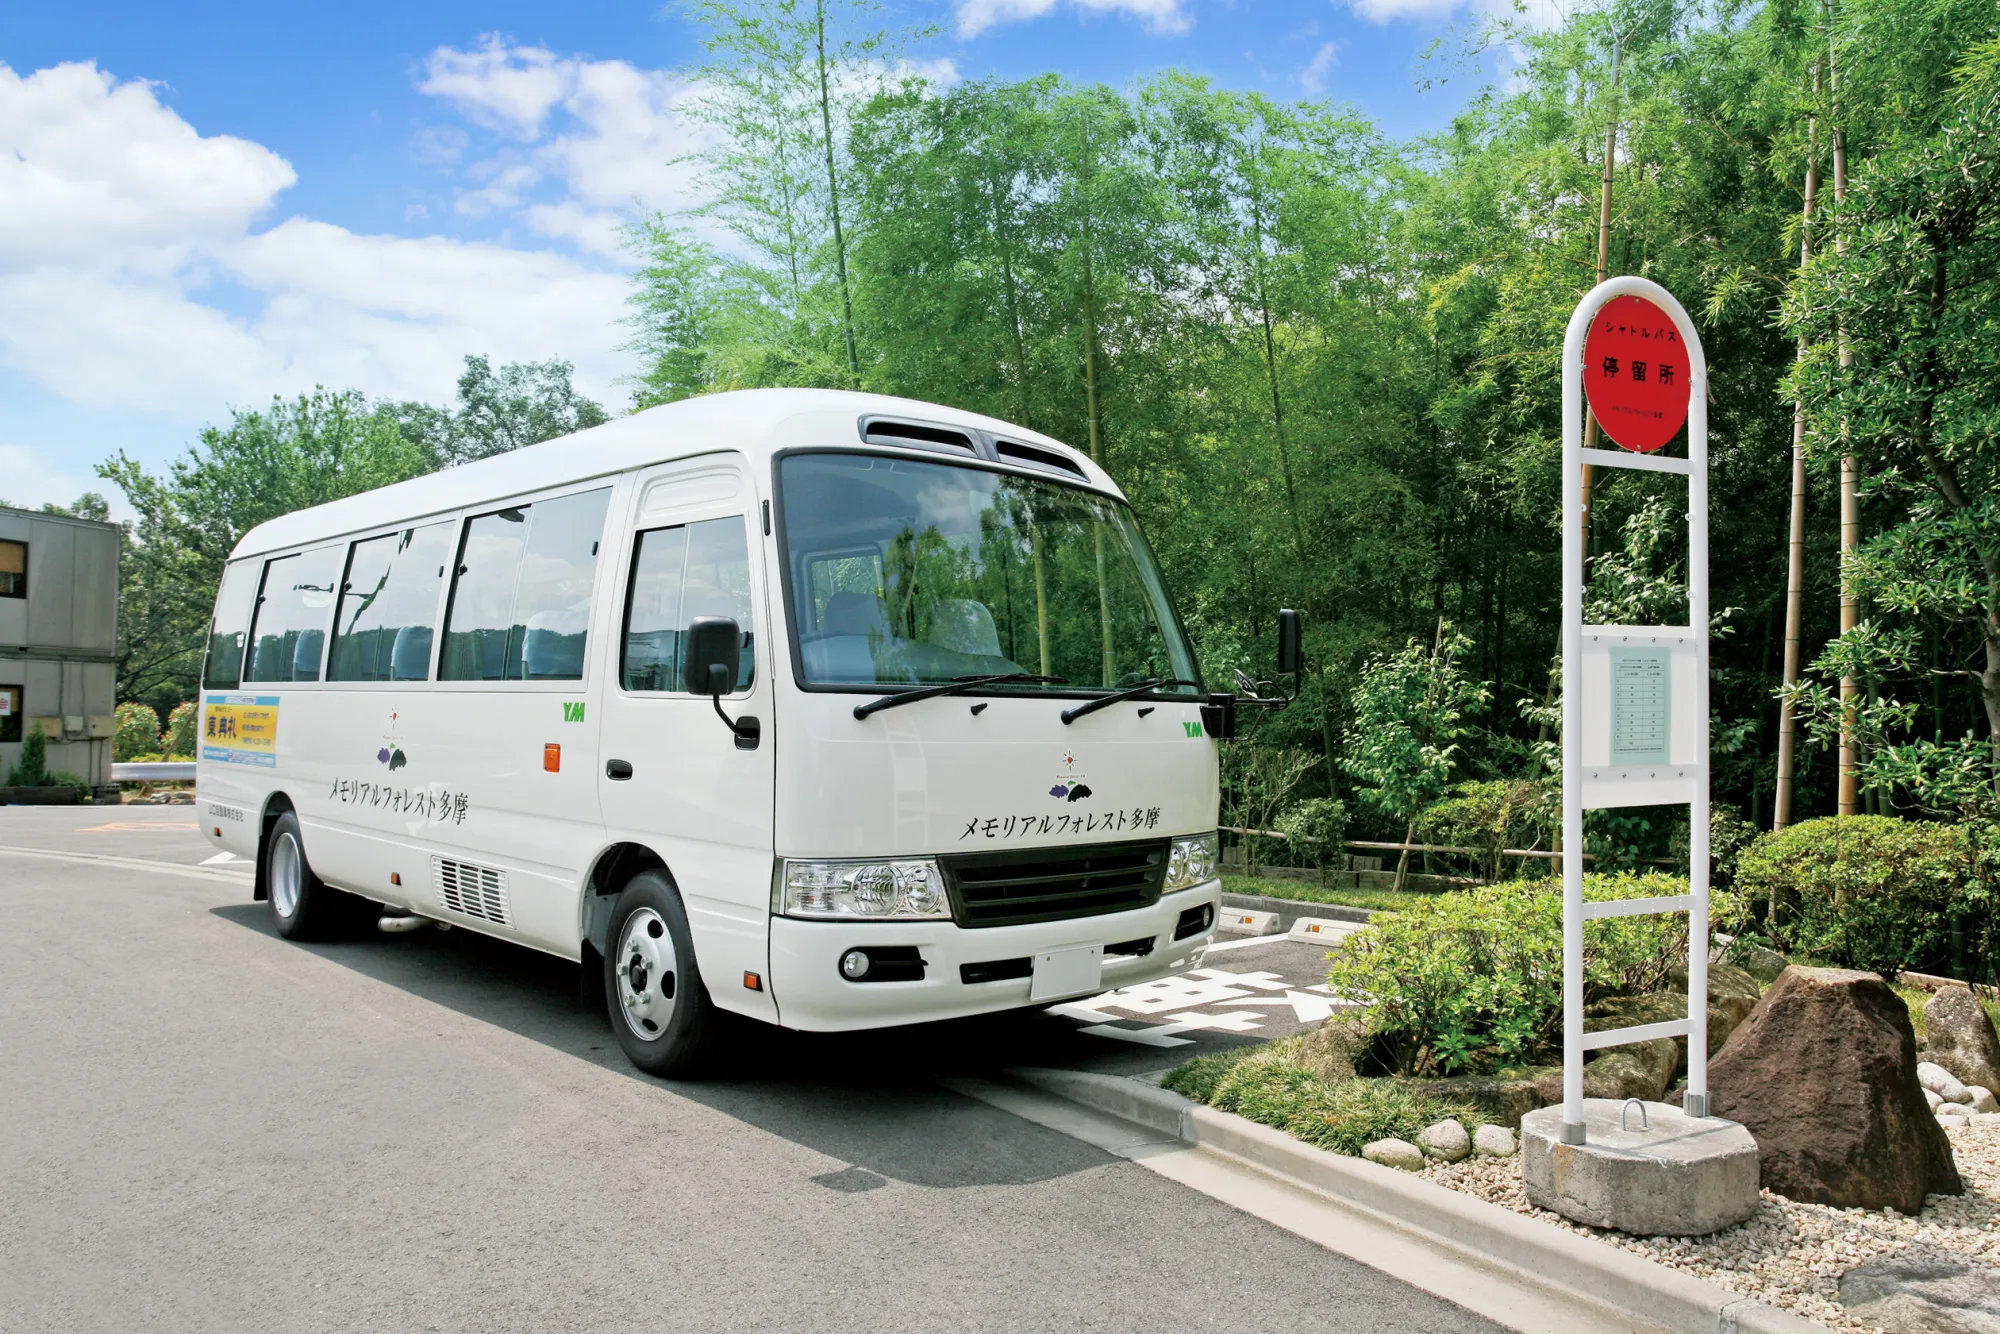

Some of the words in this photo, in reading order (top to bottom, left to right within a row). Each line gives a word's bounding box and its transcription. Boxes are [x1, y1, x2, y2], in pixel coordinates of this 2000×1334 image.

[1602, 356, 1675, 385] 停留所
[563, 703, 585, 722] YM
[329, 777, 469, 826] メモリアルフォレスト多摩
[959, 807, 1161, 841] メモリアルフォレスト多摩
